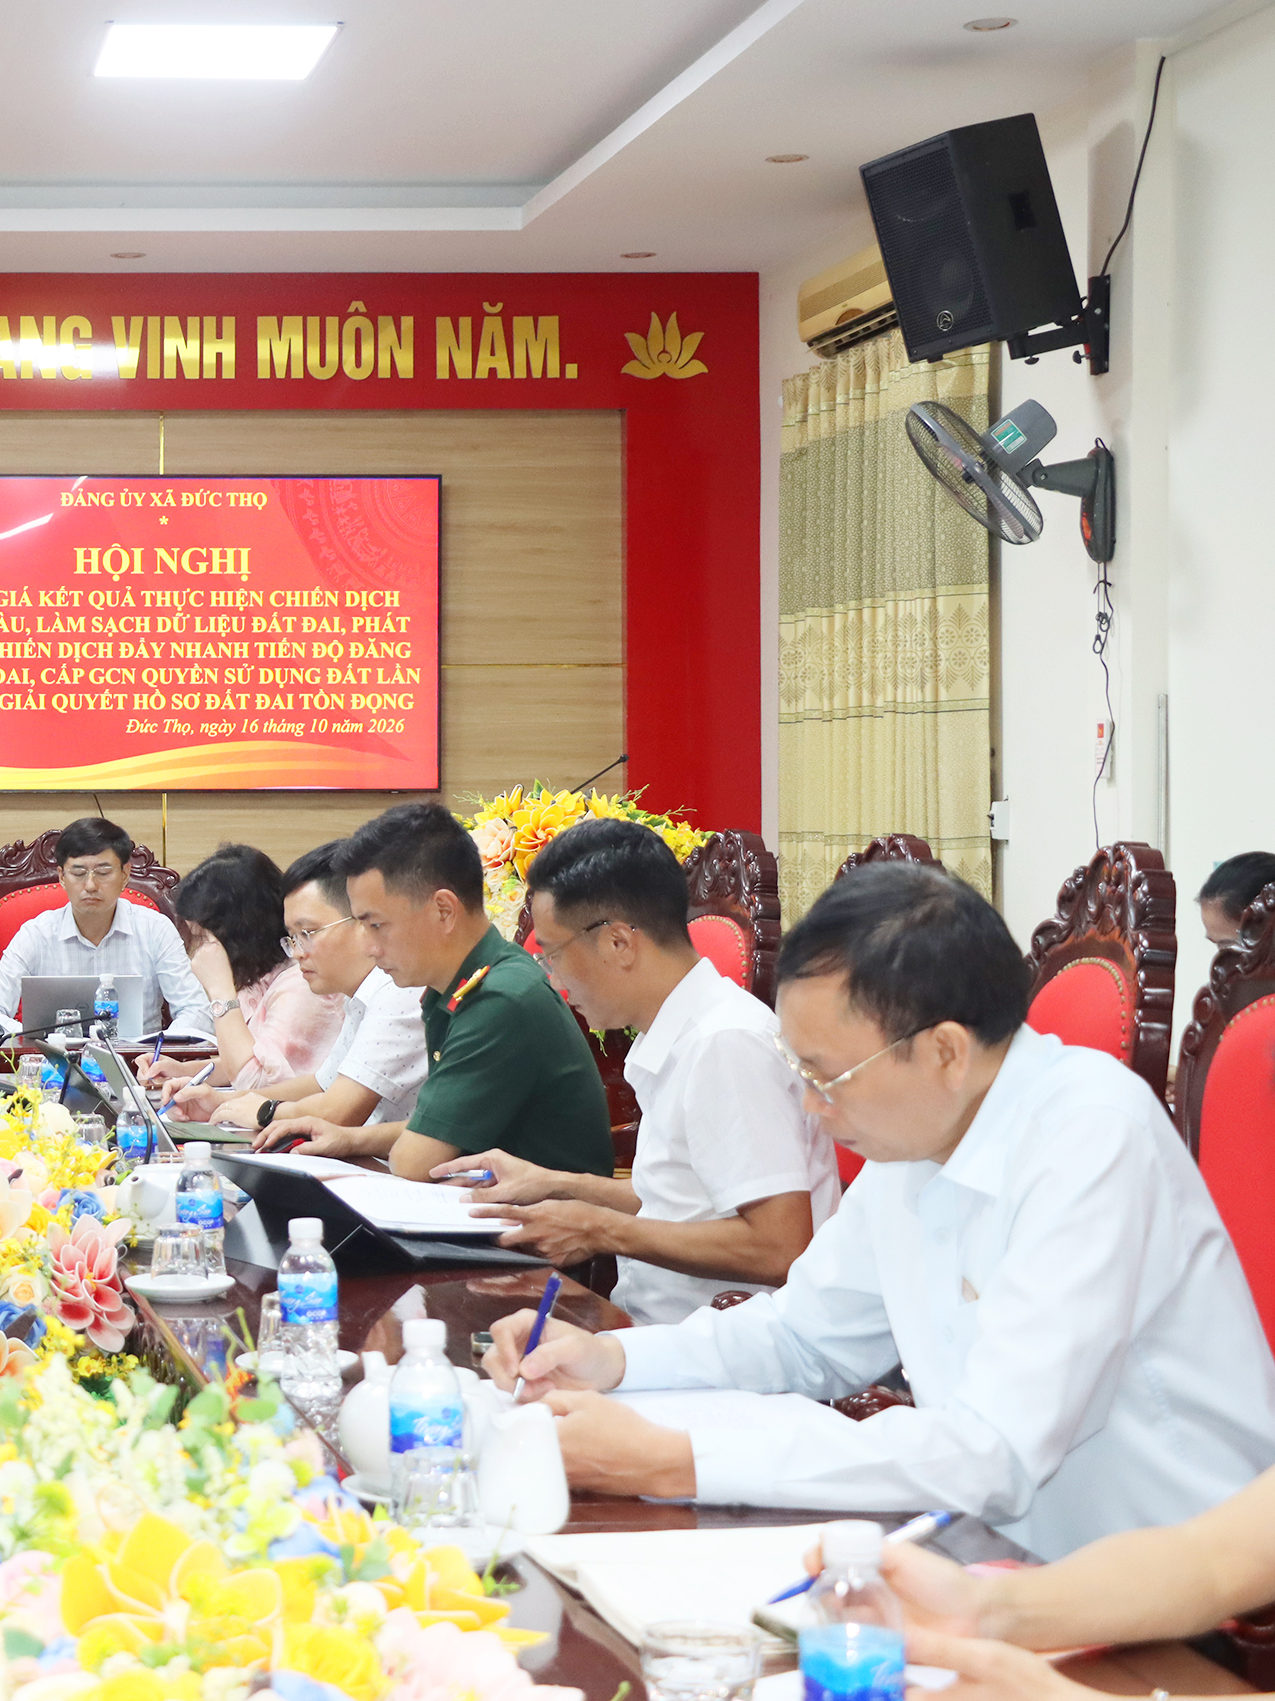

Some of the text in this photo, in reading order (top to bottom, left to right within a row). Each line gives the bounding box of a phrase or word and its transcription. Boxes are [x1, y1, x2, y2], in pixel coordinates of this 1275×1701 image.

[111, 315, 236, 379] VINH
[256, 300, 415, 379] MUÔN
[435, 301, 578, 379] NĂM.
[60, 489, 268, 511] ĐẢNG ỦY XÃ ĐỨC THỌ
[73, 542, 252, 582] HỘI NGHỊ
[38, 585, 84, 607] KẾT
[87, 585, 137, 611] QUẢ
[140, 587, 205, 612] THỰC
[210, 587, 264, 612] HIỆN
[268, 585, 339, 608] CHIẾN
[344, 590, 401, 612] DỊCH
[36, 611, 87, 633] LÀM
[91, 615, 151, 638] SẠCH
[156, 611, 191, 634] DỮ
[194, 613, 246, 638] LIỆU
[250, 611, 298, 633] ĐẤT
[300, 616, 347, 636] ĐAI,
[351, 611, 411, 634] PHÁT
[57, 641, 114, 664] DỊCH
[118, 637, 166, 659] ĐẨY
[169, 641, 250, 660] NHANH
[253, 637, 307, 659] TIẾN
[311, 639, 345, 663] ĐỘ
[348, 637, 412, 660] ĐĂNG
[40, 663, 86, 685] CẤP
[88, 667, 137, 685] GCN
[141, 662, 219, 688] QUYỀN
[223, 663, 256, 685] SỬ
[258, 667, 322, 689] DỤNG
[326, 662, 373, 685] ĐẤT
[376, 662, 422, 685] LẦN
[51, 688, 129, 714] QUYẾT
[133, 688, 167, 711] HỒ
[171, 691, 202, 711] SƠ
[204, 688, 251, 710] ĐẤT
[254, 693, 294, 710] ĐAI
[298, 688, 346, 711] TỒN
[349, 692, 415, 715] ĐỌNG
[126, 717, 405, 737] Đức Thọ, ngày 16 tháng 10 năm 2026
